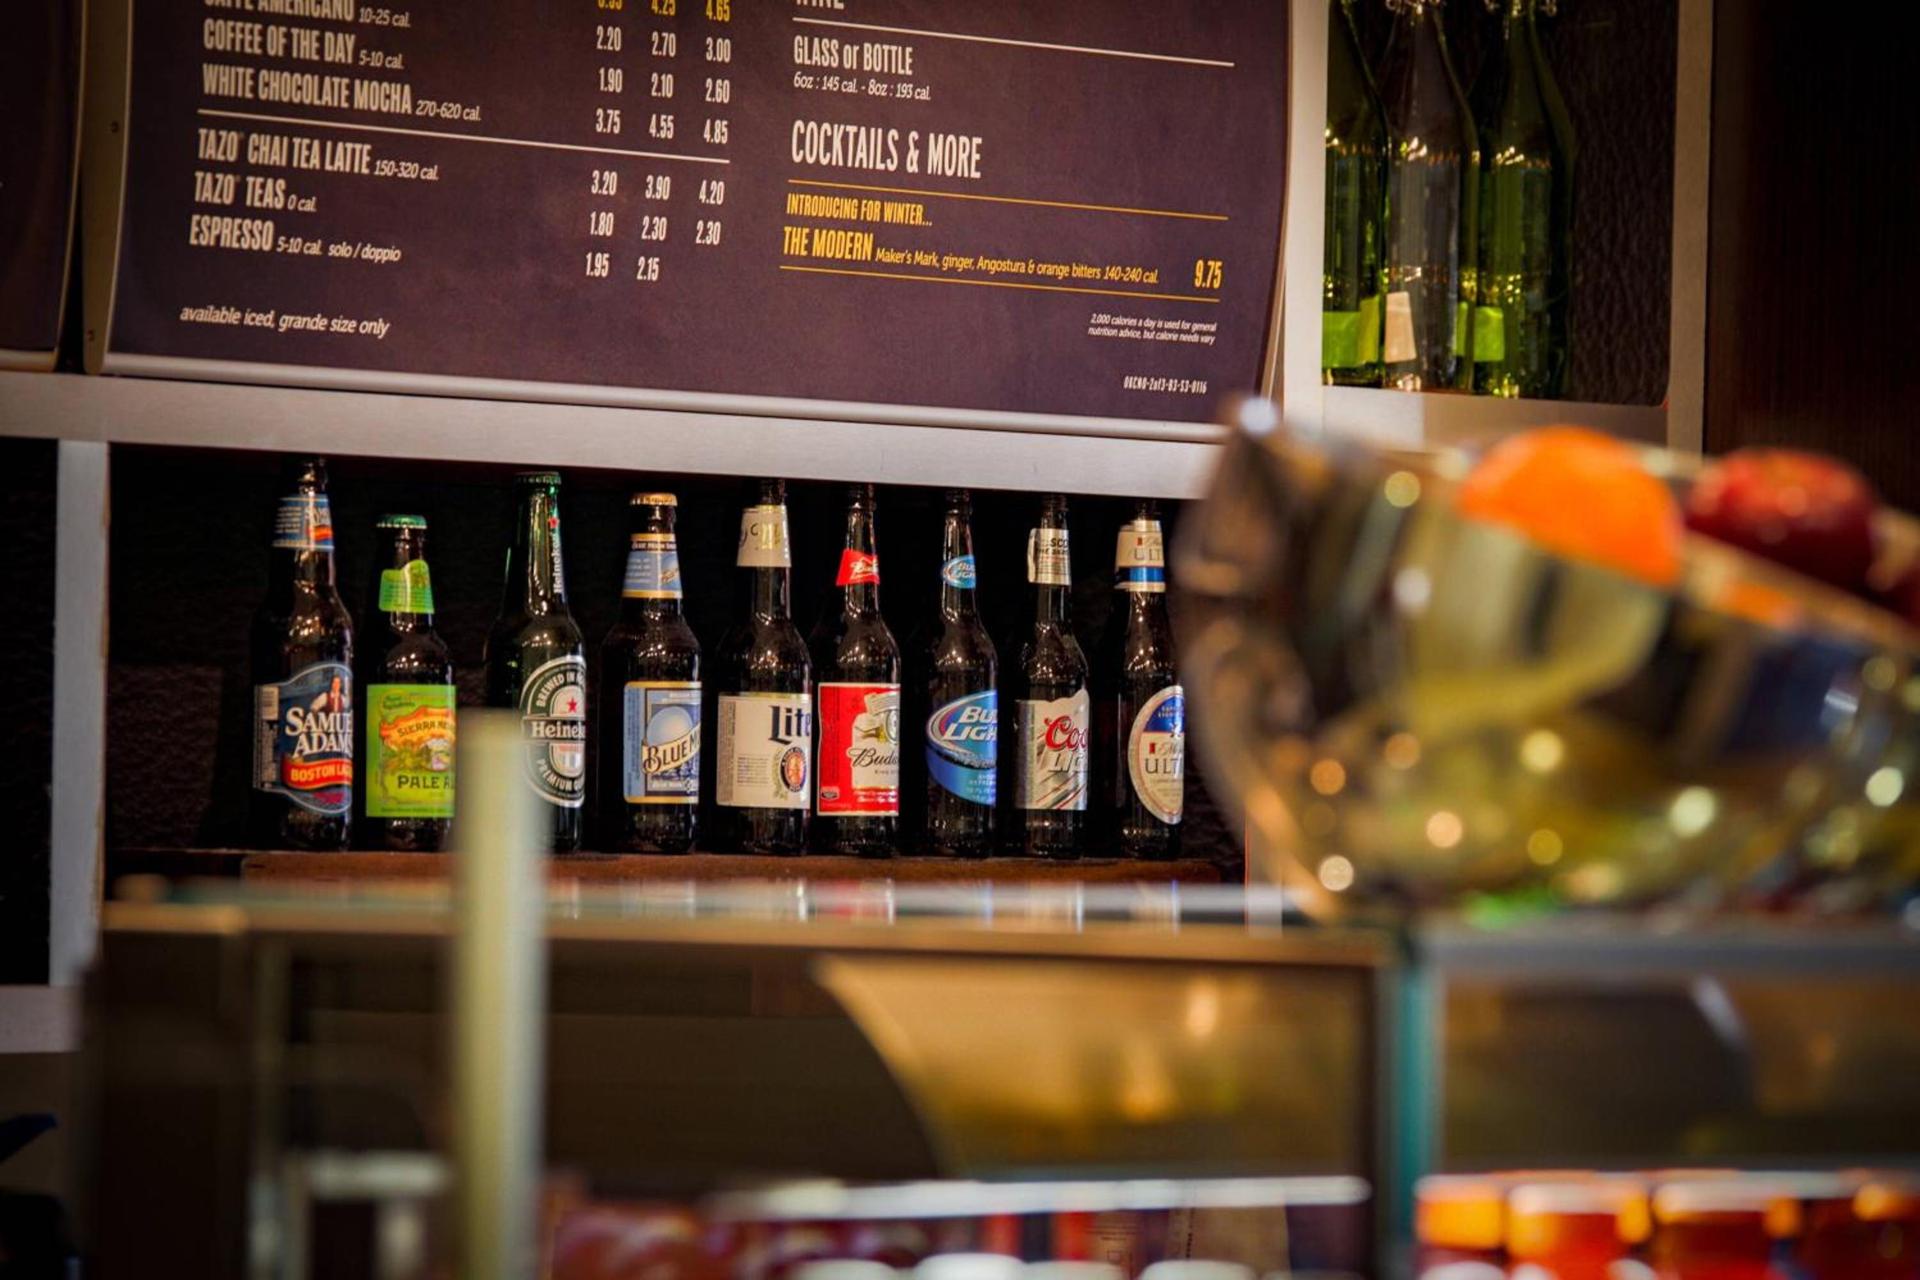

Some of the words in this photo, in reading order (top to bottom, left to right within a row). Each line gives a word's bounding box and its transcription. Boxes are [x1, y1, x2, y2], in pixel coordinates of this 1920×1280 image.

[359, 7, 389, 25] 10-25
[392, 11, 412, 27] cal.
[706, 0, 730, 22] 4.65
[203, 18, 262, 55] COFFEE
[267, 24, 287, 57] OF
[291, 27, 320, 60] THE
[324, 31, 356, 64] DAY
[359, 50, 382, 67] 5-10
[385, 54, 404, 69] cal.
[596, 25, 622, 52] 2.20
[652, 31, 676, 57] 2.70
[706, 37, 731, 63] 3.00
[794, 34, 839, 68] GLASS
[843, 44, 859, 70] or
[863, 42, 913, 76] BOTTLE
[203, 63, 254, 99] WHITE
[258, 70, 350, 109] CHOCOLATE
[354, 79, 412, 115] MOCHA
[415, 100, 461, 120] 270-620
[463, 105, 481, 121] cal.
[599, 67, 623, 93] 1.90
[651, 73, 674, 98] 2.10
[705, 78, 730, 103] 2.60
[793, 71, 813, 89] 6oz
[822, 75, 840, 91] 145
[841, 78, 858, 93] cal.
[868, 78, 888, 96] 8oz
[896, 83, 913, 99] 193
[914, 85, 932, 100] cal.
[596, 108, 621, 134] 3.75
[649, 114, 674, 139] 4.55
[704, 119, 728, 144] 4.85
[248, 133, 287, 167] CHAI
[292, 137, 320, 170] TEA
[325, 141, 371, 175] LATTE
[374, 160, 419, 178] 150-320
[420, 165, 439, 180] cal.
[792, 119, 899, 172] COCKTAILS
[906, 130, 919, 174] &
[928, 132, 982, 179] MORE
[245, 176, 286, 210] TEAS
[287, 194, 297, 210] 0
[298, 197, 316, 212] cal.
[591, 170, 617, 196] 3.20
[645, 175, 671, 200] 3.90
[699, 179, 725, 205] 4.20
[590, 211, 614, 236] 1.80
[641, 215, 667, 241] 2.30
[695, 220, 721, 245] 2.30
[787, 193, 858, 220] INTRODUCING
[860, 200, 881, 222] FOR
[884, 202, 932, 227] WINTER...
[189, 215, 274, 251] ESPRESSO
[277, 236, 302, 254] 5-10
[328, 243, 352, 257] solo
[353, 242, 361, 259] /
[361, 244, 401, 264] doppio
[784, 226, 809, 256] THE
[812, 229, 873, 261] MODERN
[875, 247, 912, 265] Maker's
[914, 250, 940, 267] Mark,
[942, 253, 974, 272] ginger,
[977, 256, 1026, 276] Angostura
[1027, 260, 1035, 273] &
[1036, 263, 1069, 280] orange
[1071, 262, 1101, 279] bitters
[1103, 266, 1142, 283] 140-240
[1143, 269, 1159, 284] cal.
[1194, 259, 1223, 289] 9.75
[586, 252, 610, 278] 1.95
[636, 256, 660, 282] 2.15
[180, 305, 242, 324] available
[243, 308, 275, 328] iced,
[278, 313, 327, 332] grande
[329, 315, 357, 333] size
[359, 318, 390, 339] only
[1181, 320, 1191, 330] for
[768, 705, 811, 745] Lite
[643, 731, 688, 775] BLUE
[291, 764, 335, 782] BOSTON
[397, 775, 440, 790] PALE
